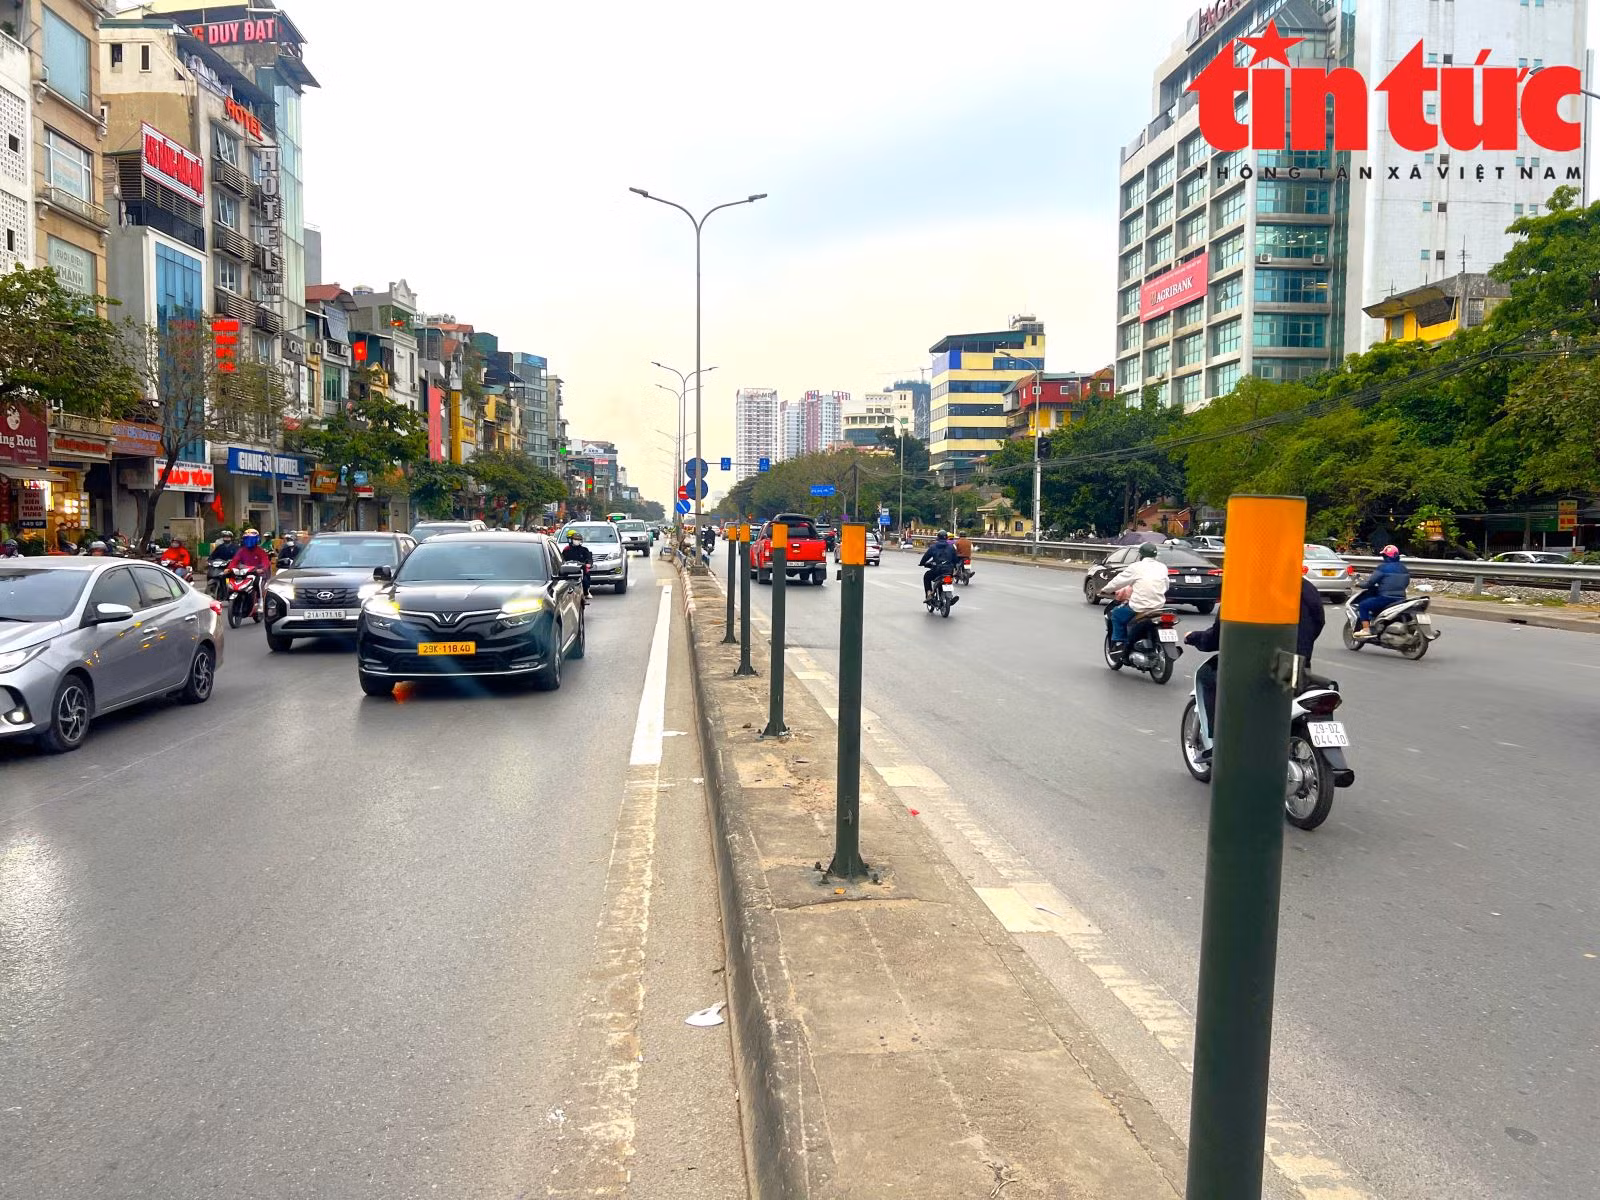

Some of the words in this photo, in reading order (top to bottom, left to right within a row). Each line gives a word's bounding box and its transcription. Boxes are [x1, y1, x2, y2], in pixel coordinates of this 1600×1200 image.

[208, 23, 239, 44] DUY
[244, 19, 275, 43] ĐẠT
[225, 96, 264, 141] HOTEL
[260, 151, 278, 270] HOTEL
[1156, 275, 1194, 304] AGRIBANK
[16, 434, 37, 448] Roti
[423, 644, 471, 654] 29K-118.40
